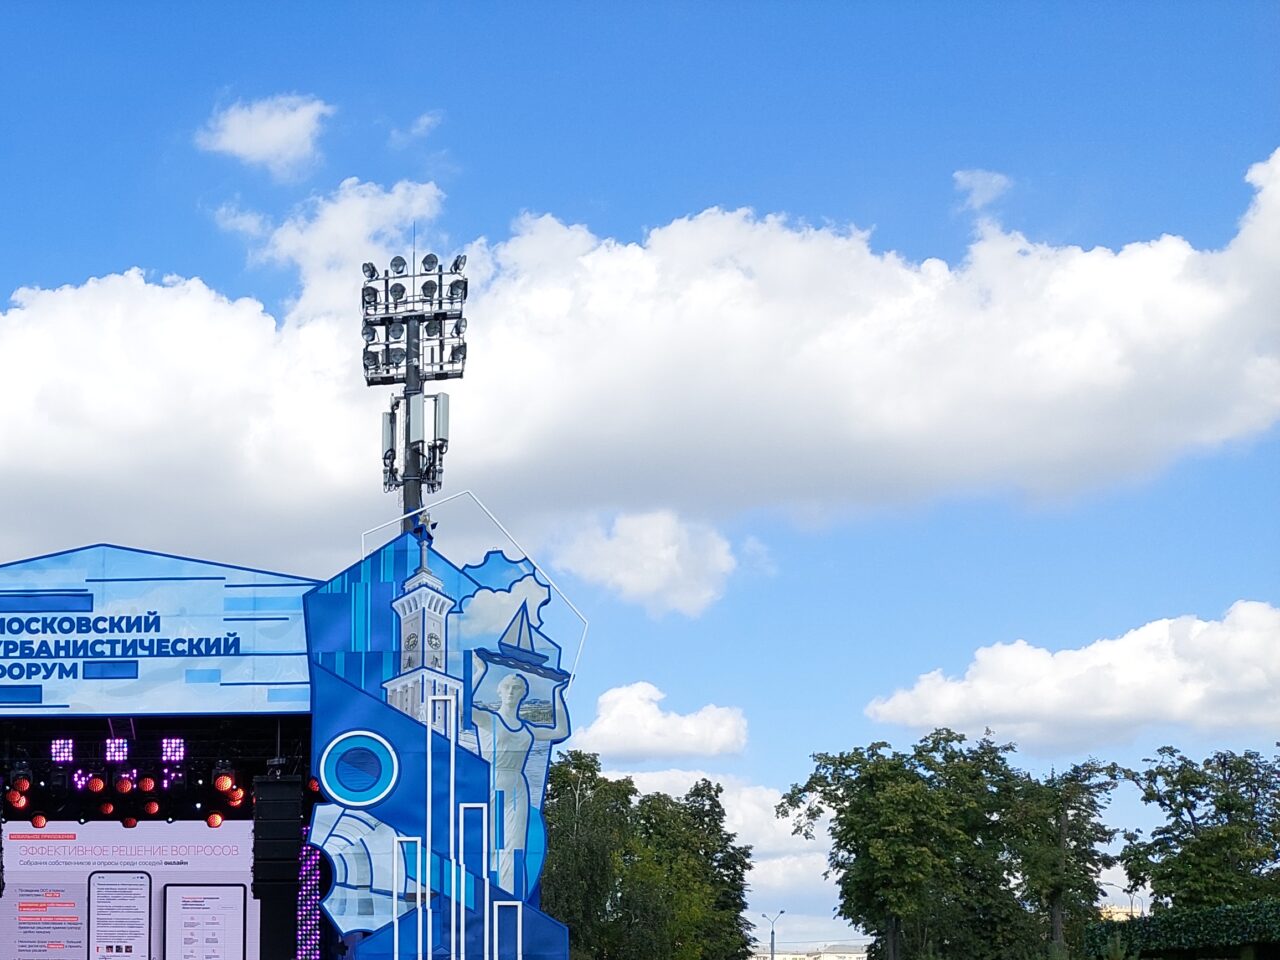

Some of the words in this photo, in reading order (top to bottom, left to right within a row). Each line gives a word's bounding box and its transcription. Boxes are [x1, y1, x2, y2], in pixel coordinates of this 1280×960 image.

[19, 845, 109, 856] ЭФФЕКТИВНОЕ
[112, 845, 168, 856] РЕШЕНИЕ
[171, 845, 239, 856] ВОПРОСОВ
